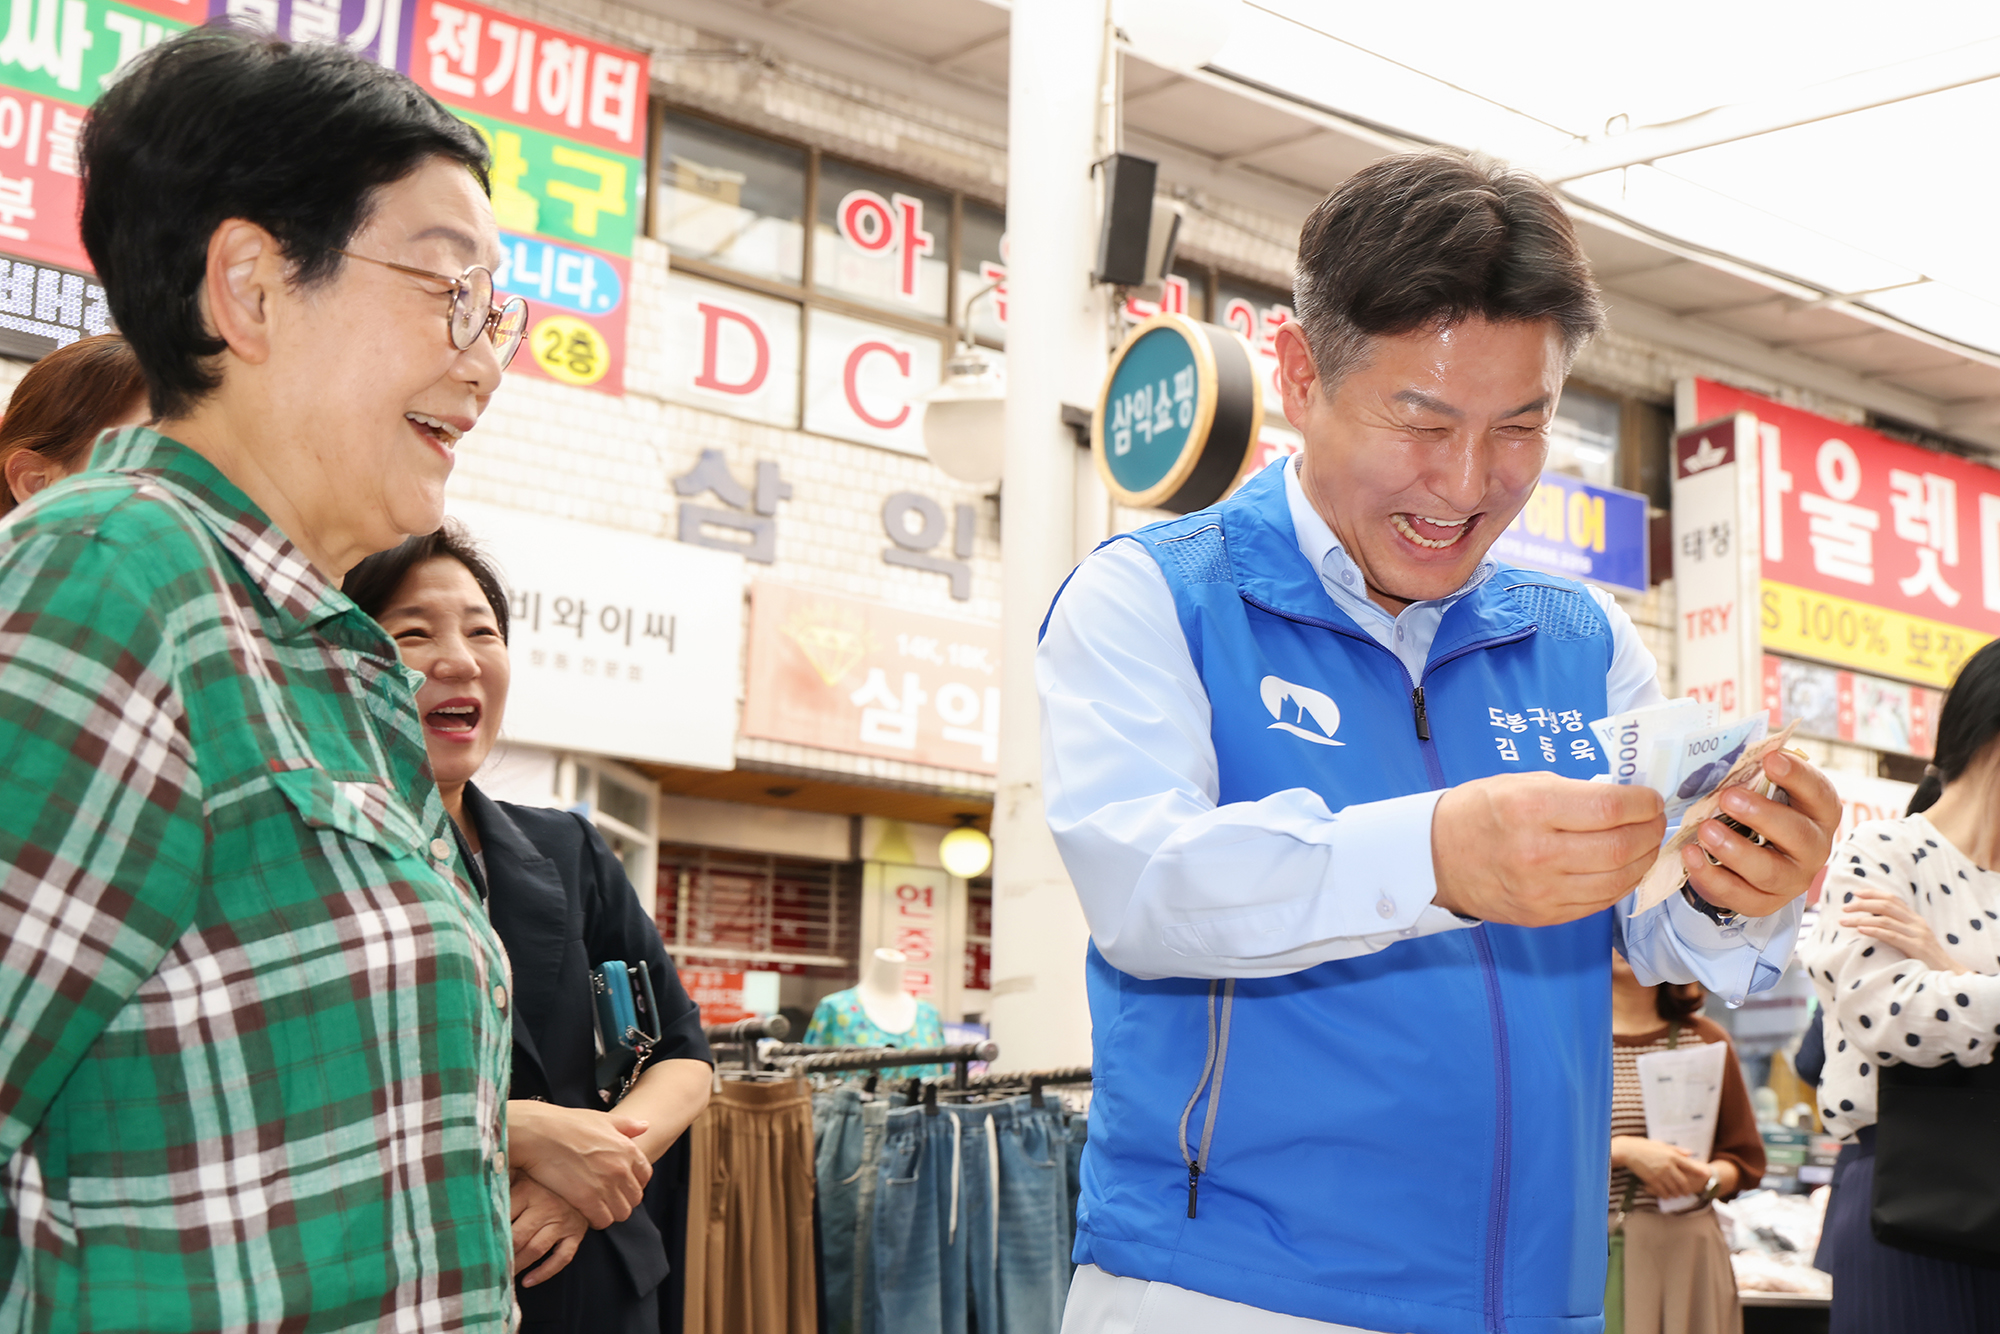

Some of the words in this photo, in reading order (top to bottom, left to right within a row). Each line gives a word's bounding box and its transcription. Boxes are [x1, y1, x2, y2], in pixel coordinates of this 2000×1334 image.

[427, 6, 640, 143] 전기히터
[543, 328, 598, 376] 2층
[1111, 364, 1194, 457] 삼익쇼핑
[1508, 482, 1606, 553] 헤어
[1682, 520, 1731, 562] 태창
[509, 588, 677, 655] 비와이씨
[1684, 601, 1733, 640] TRY
[1799, 598, 1889, 656] 100%
[850, 666, 1001, 764] 삼익
[1618, 719, 1640, 777] 1000
[1687, 737, 1719, 757] 1000
